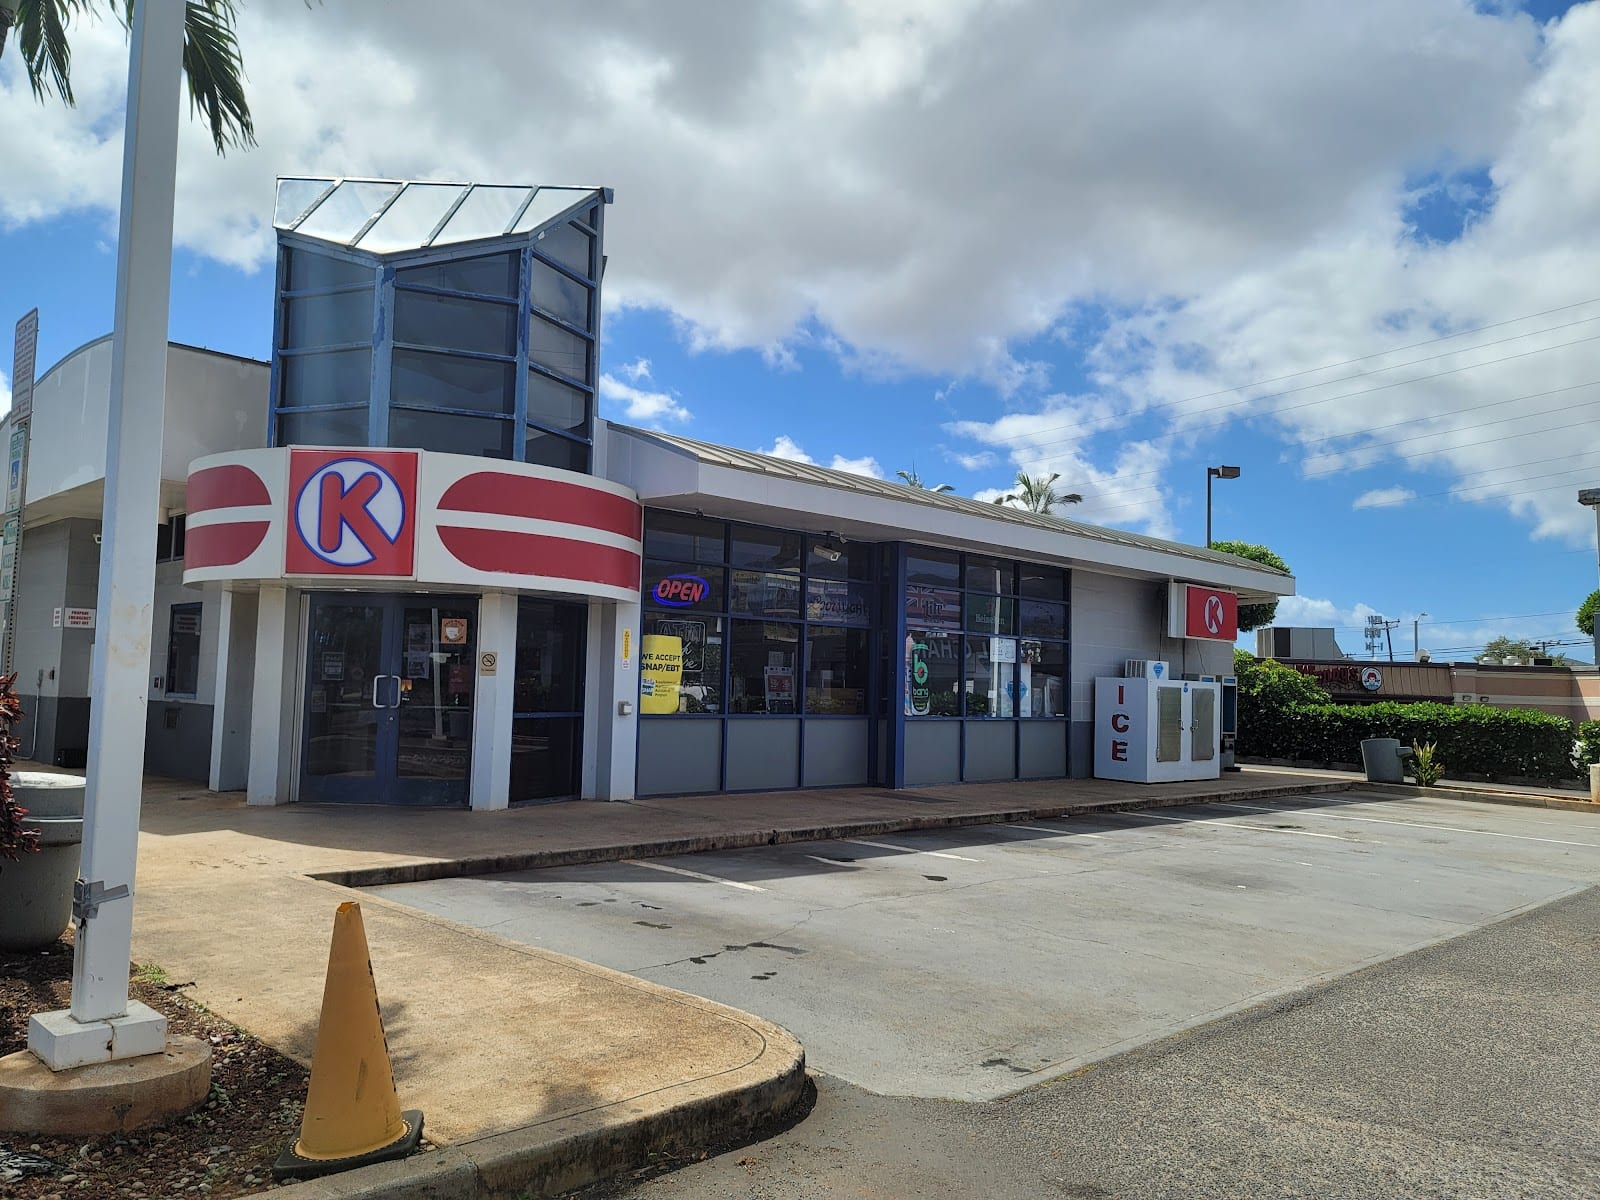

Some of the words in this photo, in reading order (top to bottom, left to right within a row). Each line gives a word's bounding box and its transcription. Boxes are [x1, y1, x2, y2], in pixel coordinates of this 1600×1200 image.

[316, 470, 397, 564] K
[656, 578, 705, 603] OPEN
[655, 654, 681, 662] ACCEPT
[1111, 685, 1130, 763] ICE
